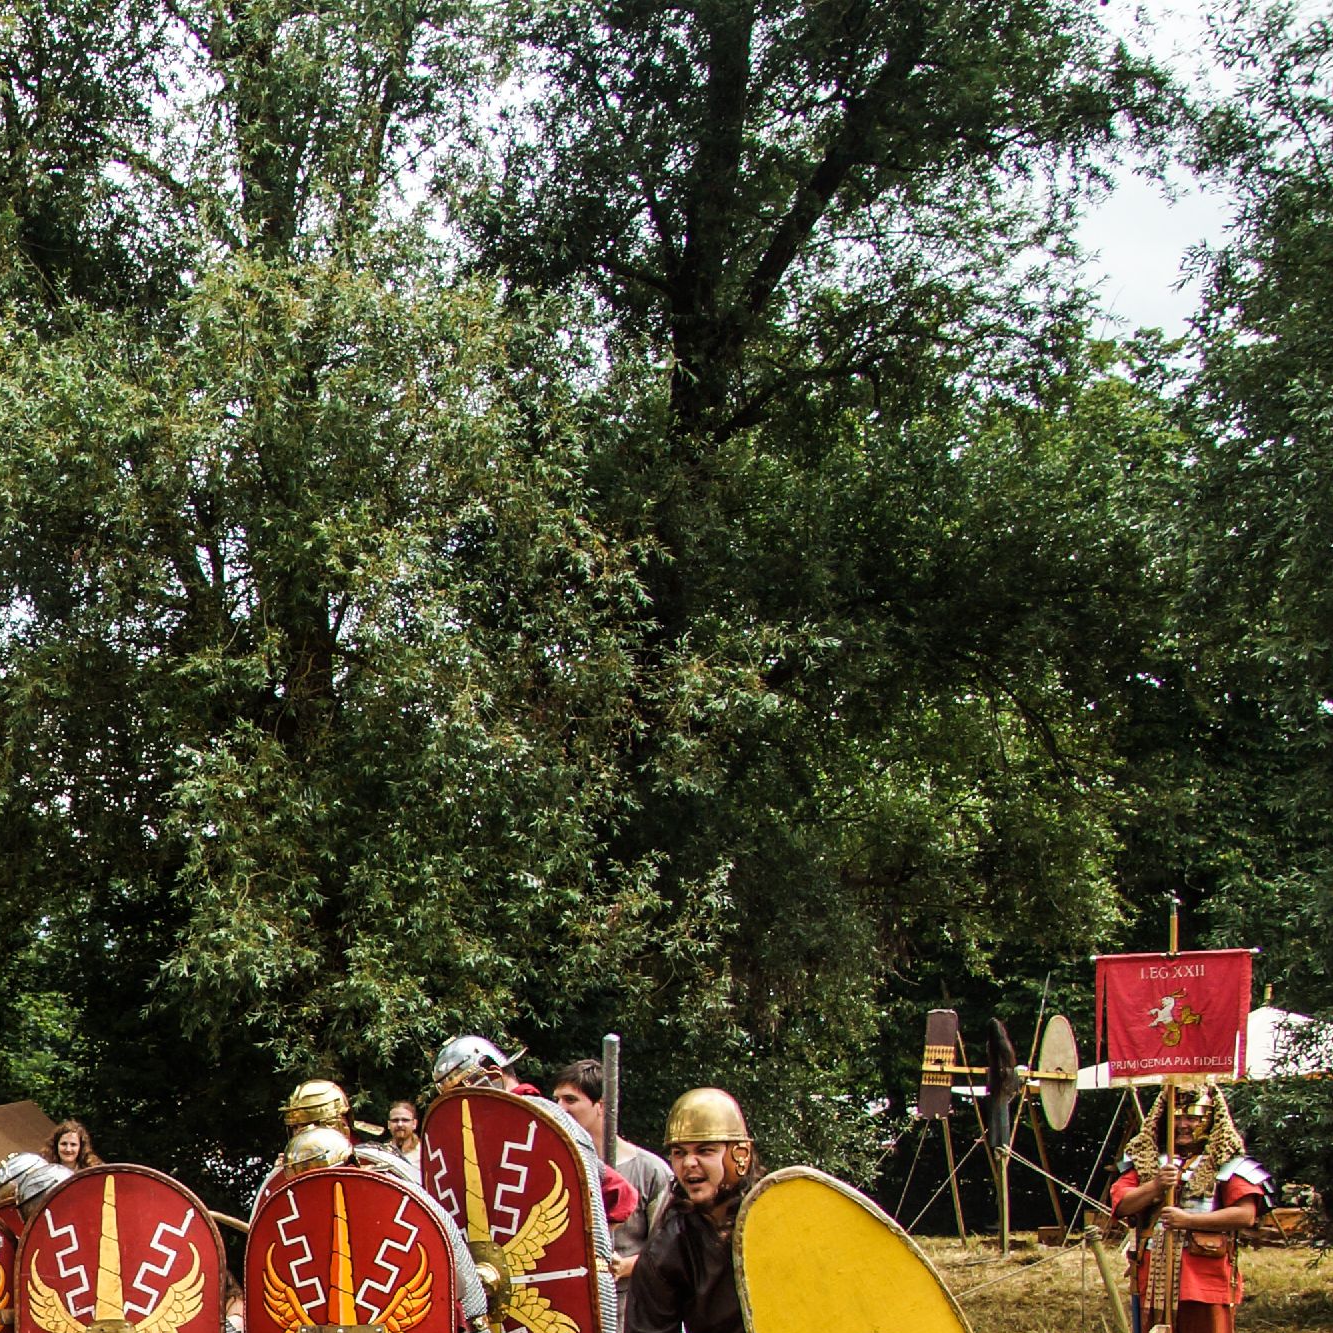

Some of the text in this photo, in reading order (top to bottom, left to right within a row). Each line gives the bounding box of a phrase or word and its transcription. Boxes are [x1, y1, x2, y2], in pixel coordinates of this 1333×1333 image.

[1140, 964, 1205, 980] LEG XXII
[1110, 1056, 1233, 1071] PRIMIGENIA PIA FIDELIS
